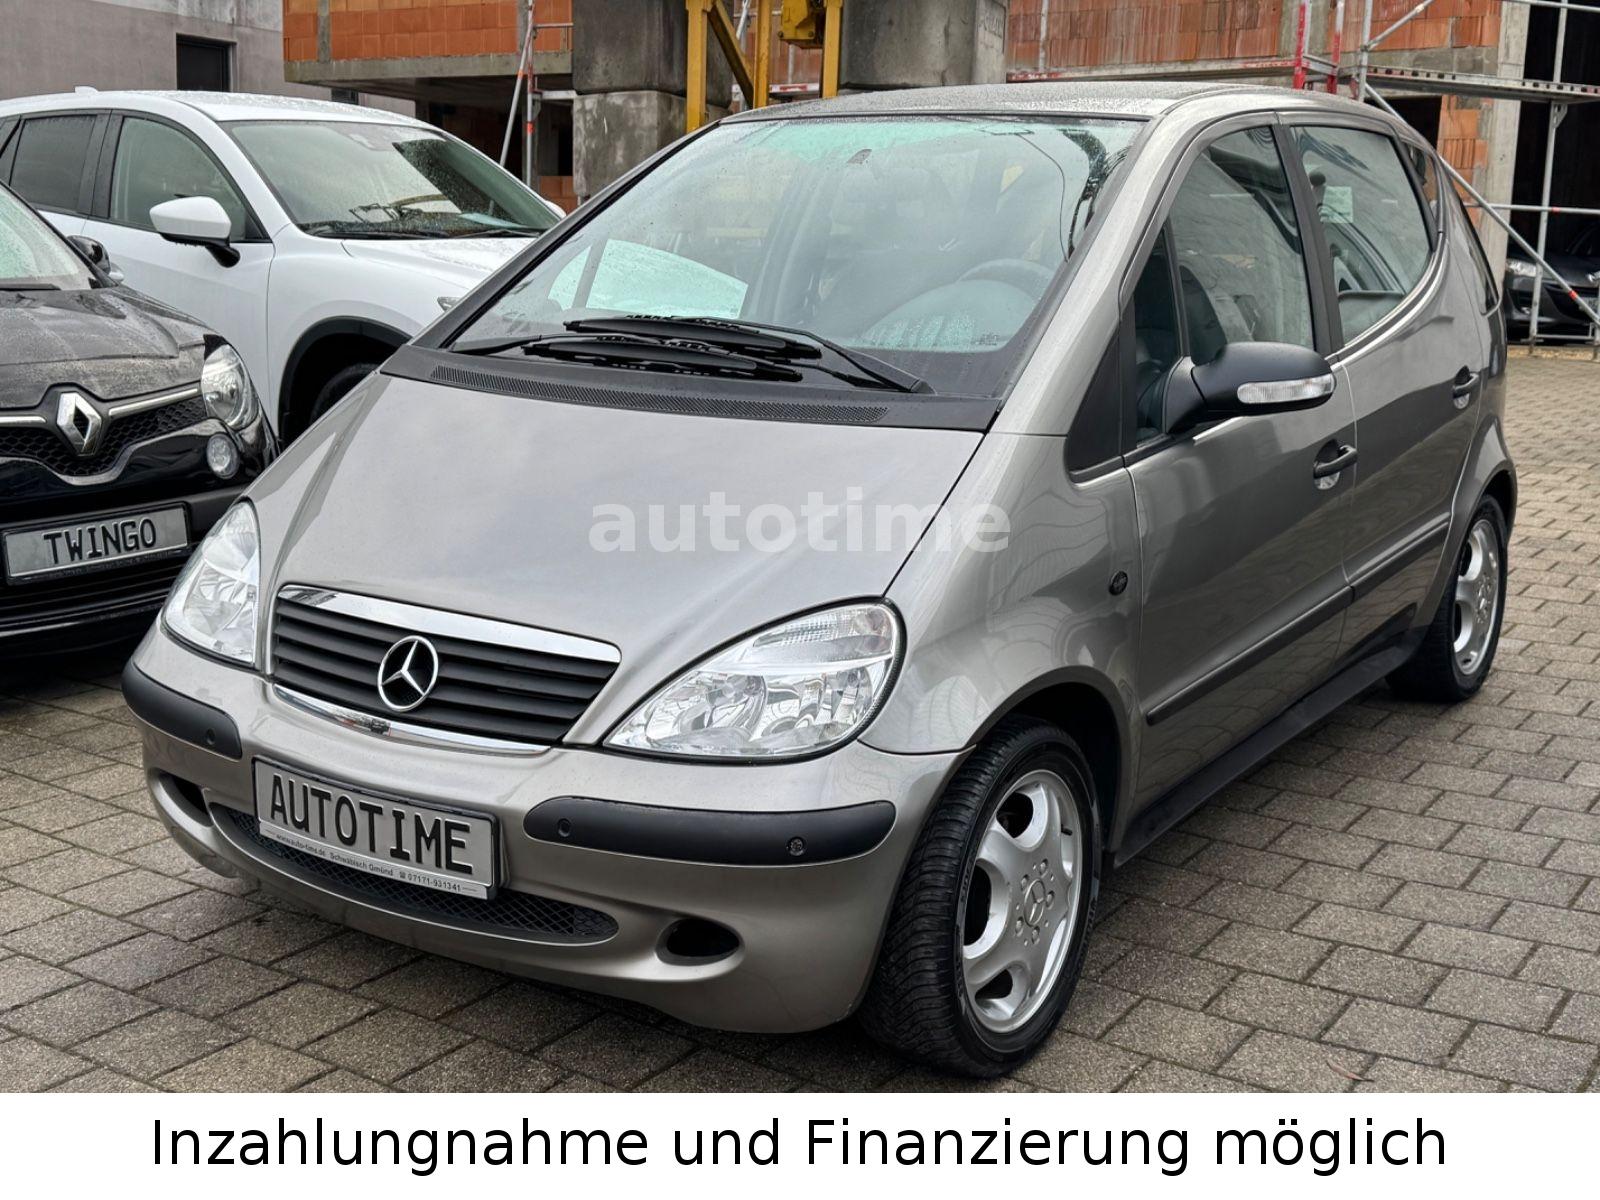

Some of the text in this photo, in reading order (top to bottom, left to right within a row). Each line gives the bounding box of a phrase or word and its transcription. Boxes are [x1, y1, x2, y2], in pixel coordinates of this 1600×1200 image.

[43, 518, 156, 564] TWINGO
[271, 774, 473, 874] AUTOTIME
[407, 873, 460, 891] 07171-931341
